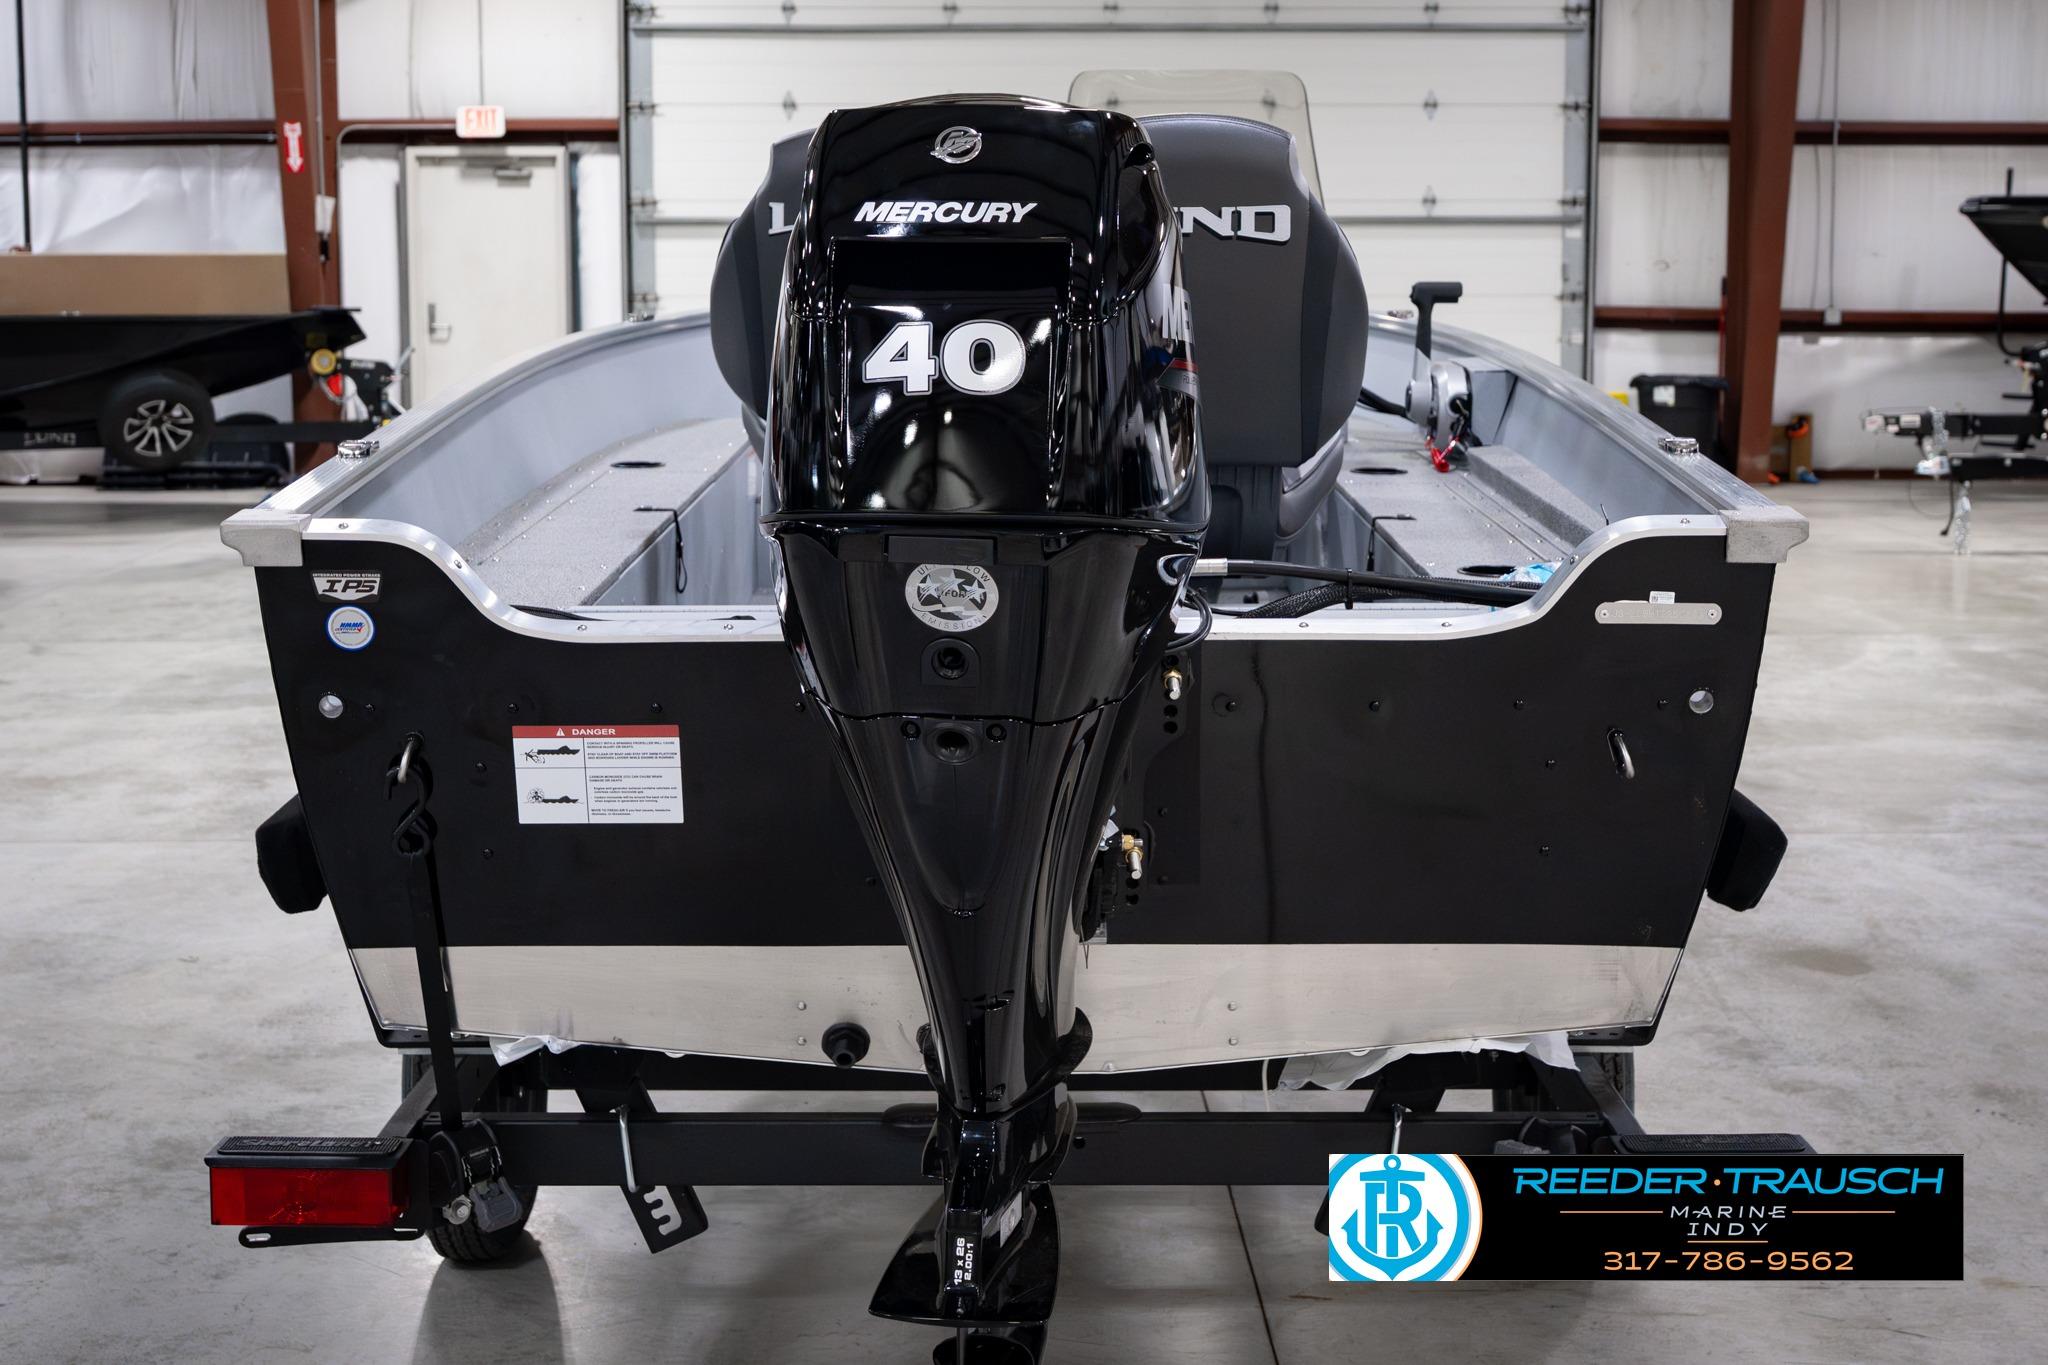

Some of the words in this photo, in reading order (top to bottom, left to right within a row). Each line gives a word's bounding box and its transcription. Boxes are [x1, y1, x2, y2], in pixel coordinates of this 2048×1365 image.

[464, 108, 497, 130] EXIT
[853, 201, 1038, 224] MERCURY
[1173, 204, 1292, 243] ND
[861, 319, 1027, 396] 40
[966, 565, 992, 583] LOW
[322, 579, 378, 593] IPS
[572, 728, 616, 736] DANGER
[955, 1237, 966, 1257] 26
[963, 1242, 974, 1281] 2.00:1
[953, 1269, 963, 1286] 13
